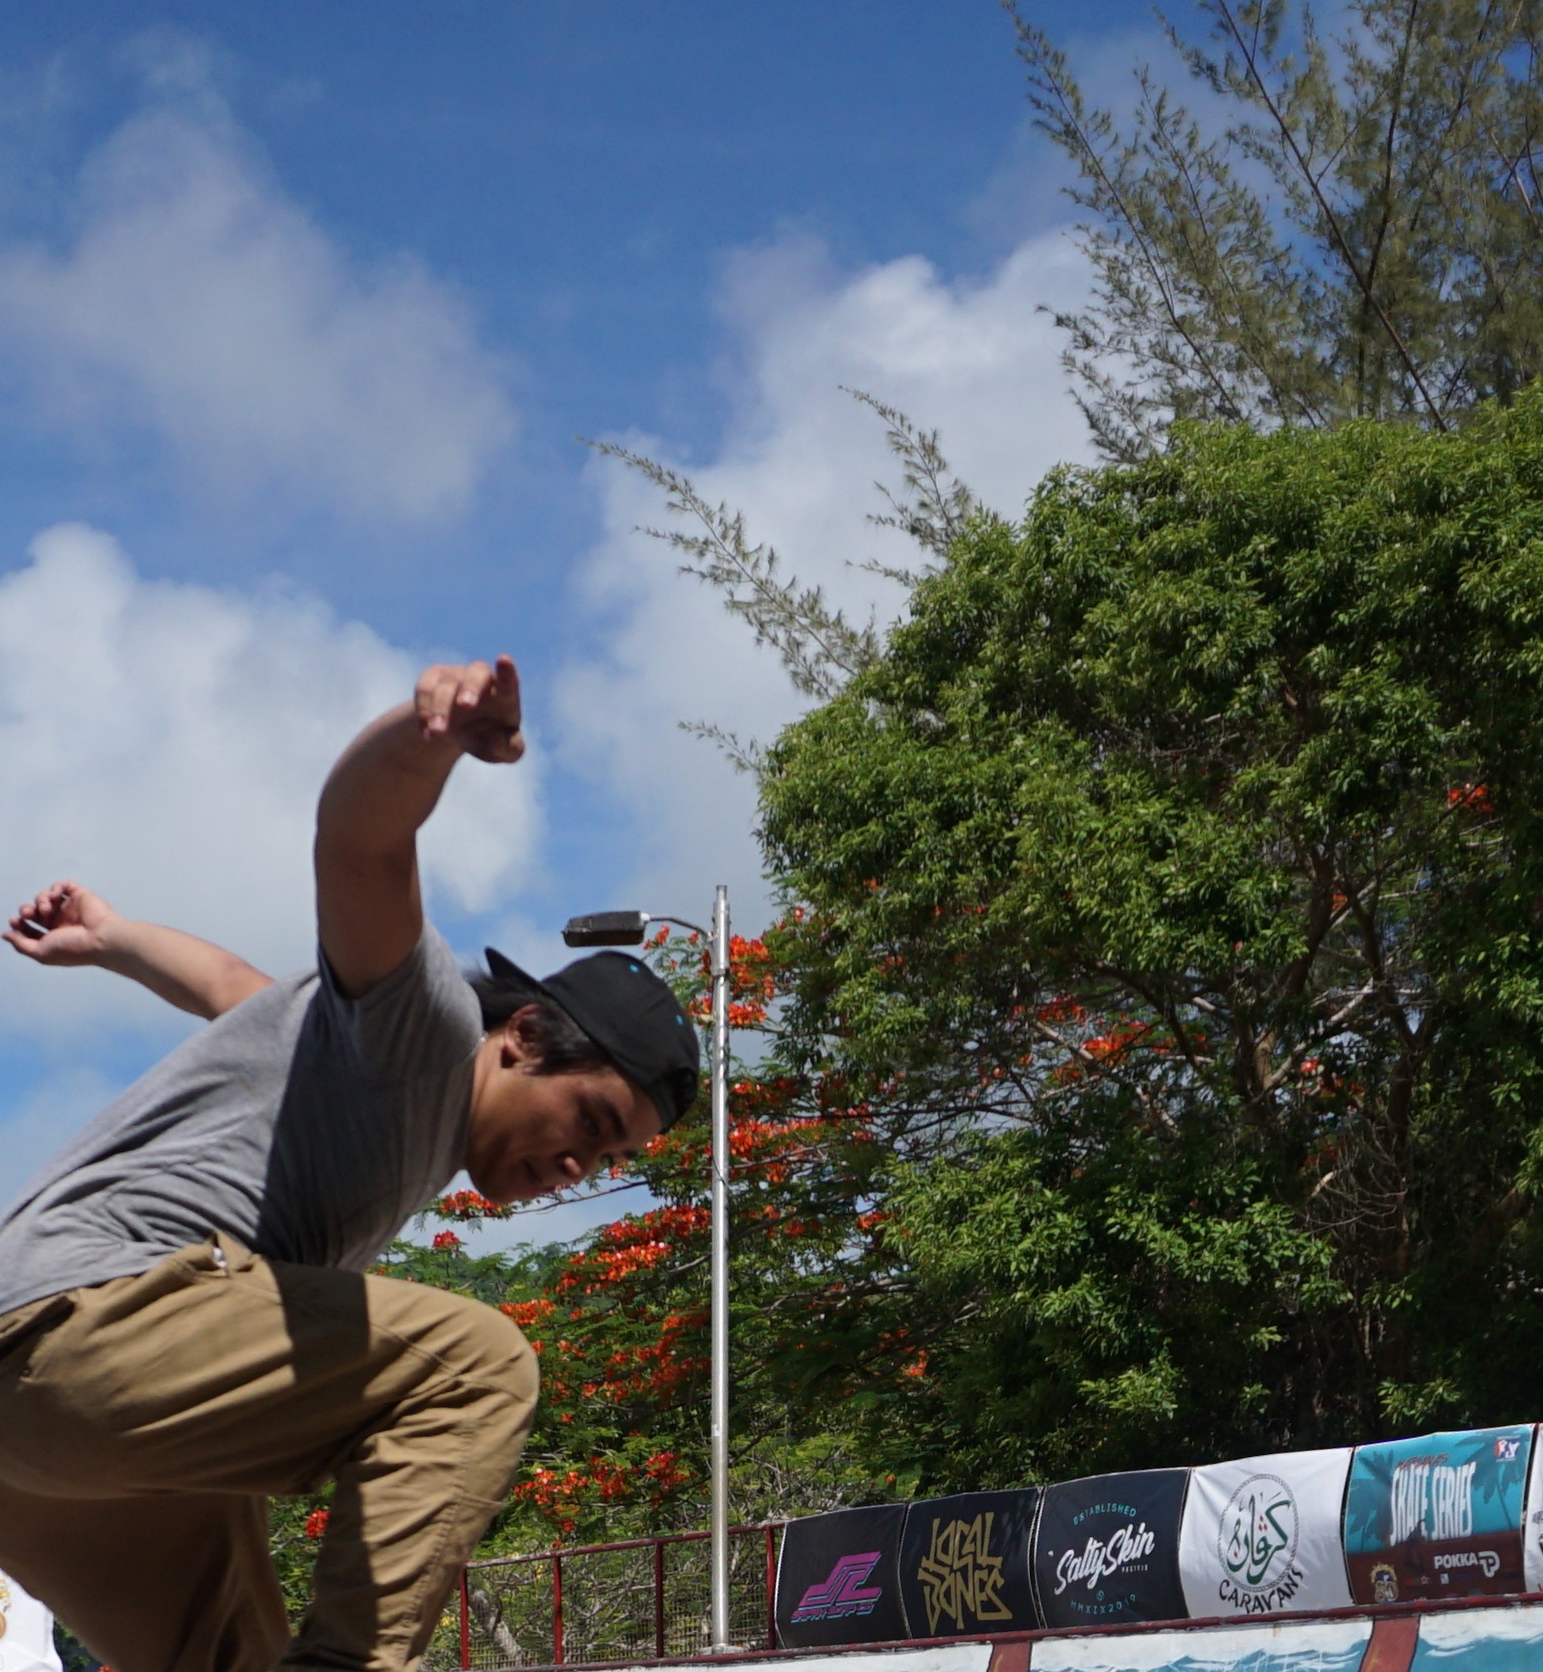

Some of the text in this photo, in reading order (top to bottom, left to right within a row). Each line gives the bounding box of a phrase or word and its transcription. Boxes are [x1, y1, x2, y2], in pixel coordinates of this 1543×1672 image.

[1073, 1503, 1137, 1525] ESTABLISHED
[1390, 1461, 1477, 1547] SKATE SERIES
[1434, 1552, 1478, 1569] POKKA
[1219, 1567, 1304, 1614] CARAVANS
